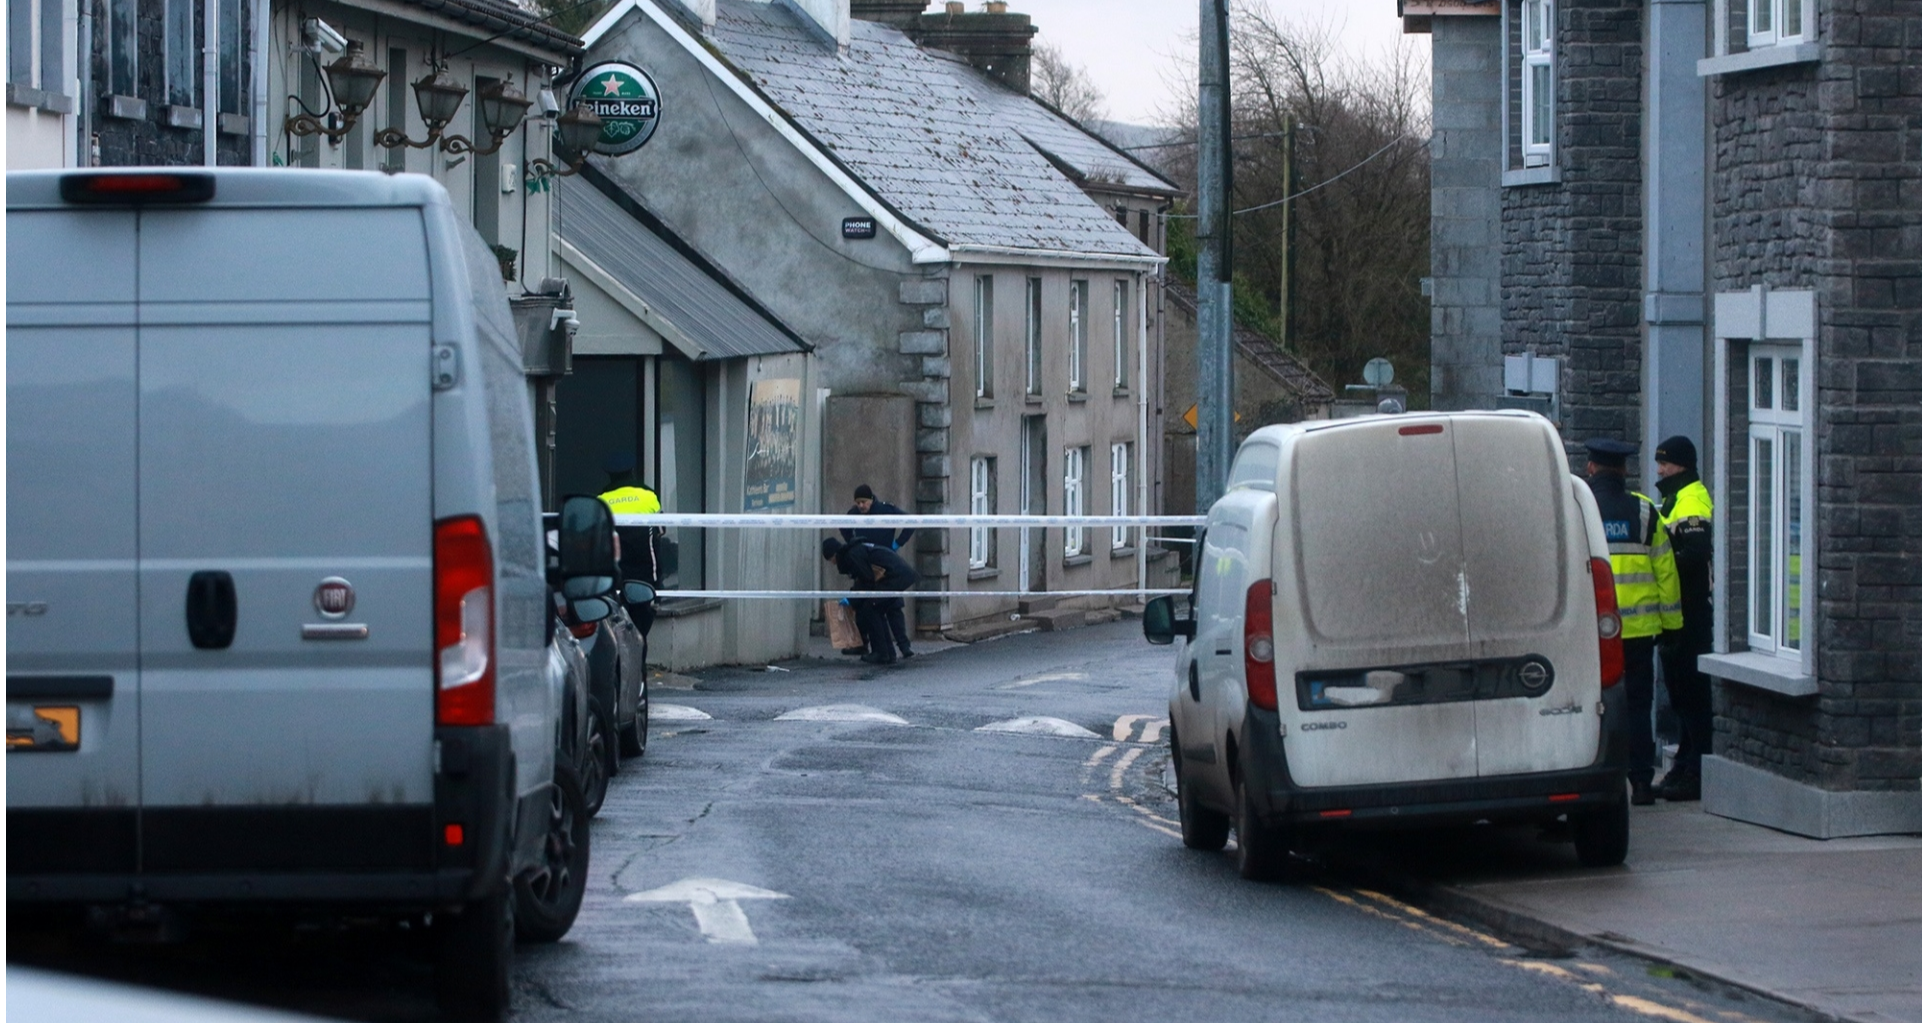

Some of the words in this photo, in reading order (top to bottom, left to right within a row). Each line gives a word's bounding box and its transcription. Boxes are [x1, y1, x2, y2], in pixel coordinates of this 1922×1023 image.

[608, 496, 640, 505] GARDA
[1606, 523, 1628, 536] RDA
[1301, 721, 1347, 731] COMBO
